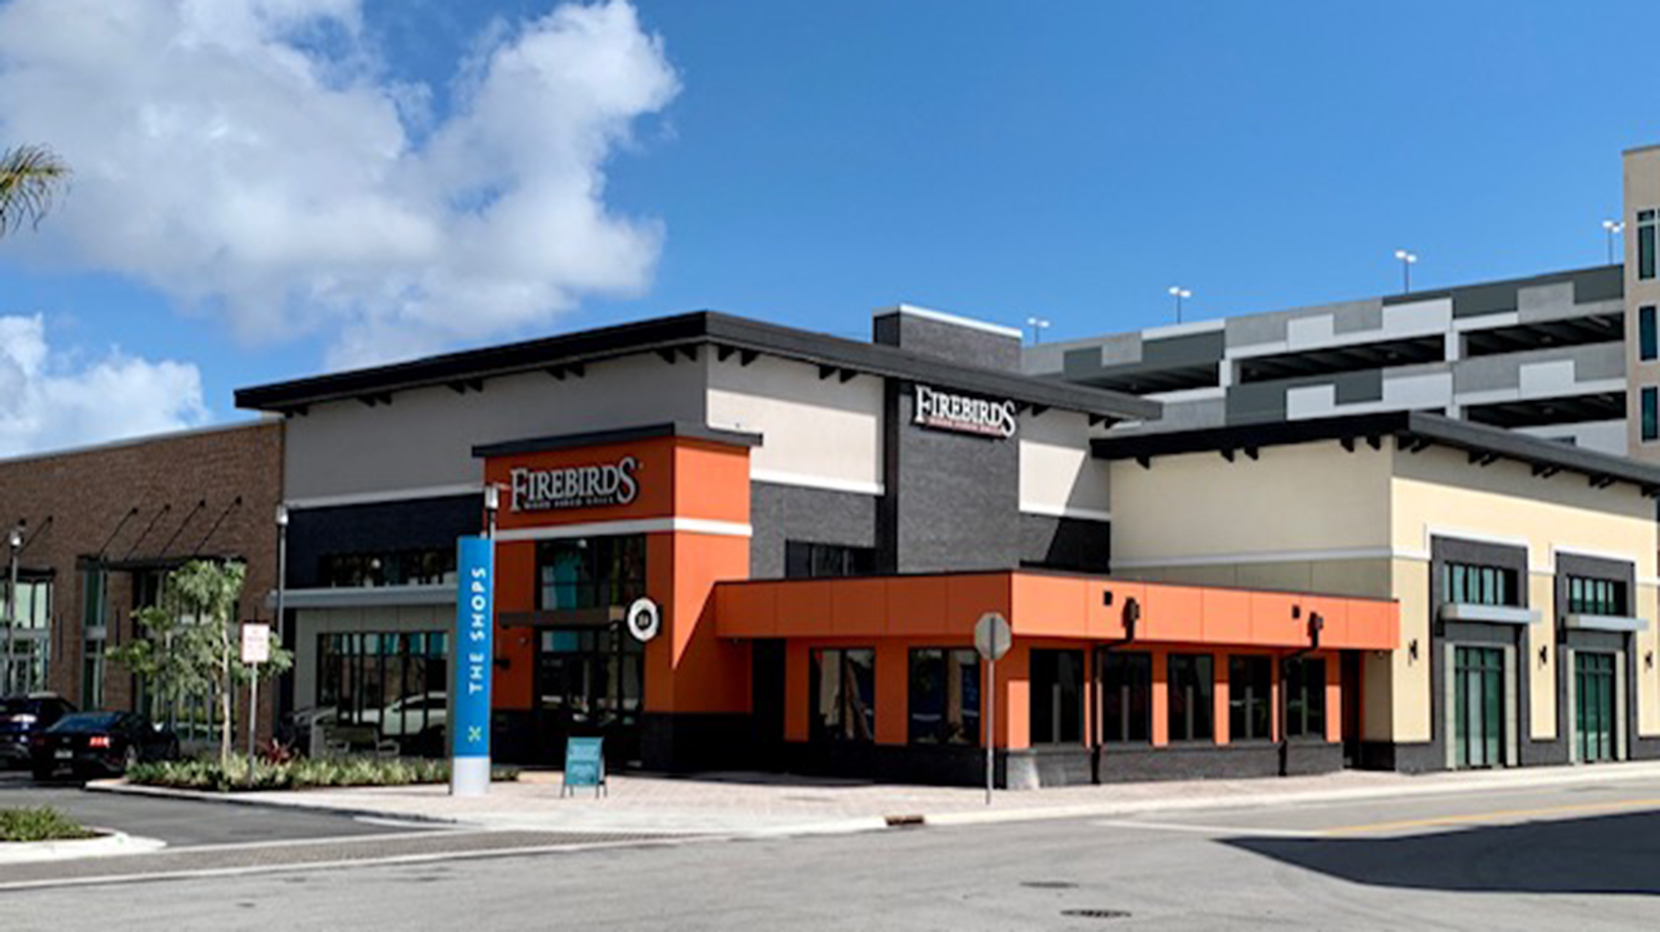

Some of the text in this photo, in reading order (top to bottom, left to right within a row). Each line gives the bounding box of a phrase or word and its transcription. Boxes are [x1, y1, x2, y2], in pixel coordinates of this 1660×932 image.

[915, 385, 1016, 437] FIREBIRDS
[509, 456, 637, 511] FIREBIRDS
[469, 567, 486, 695] THE SHOPS
